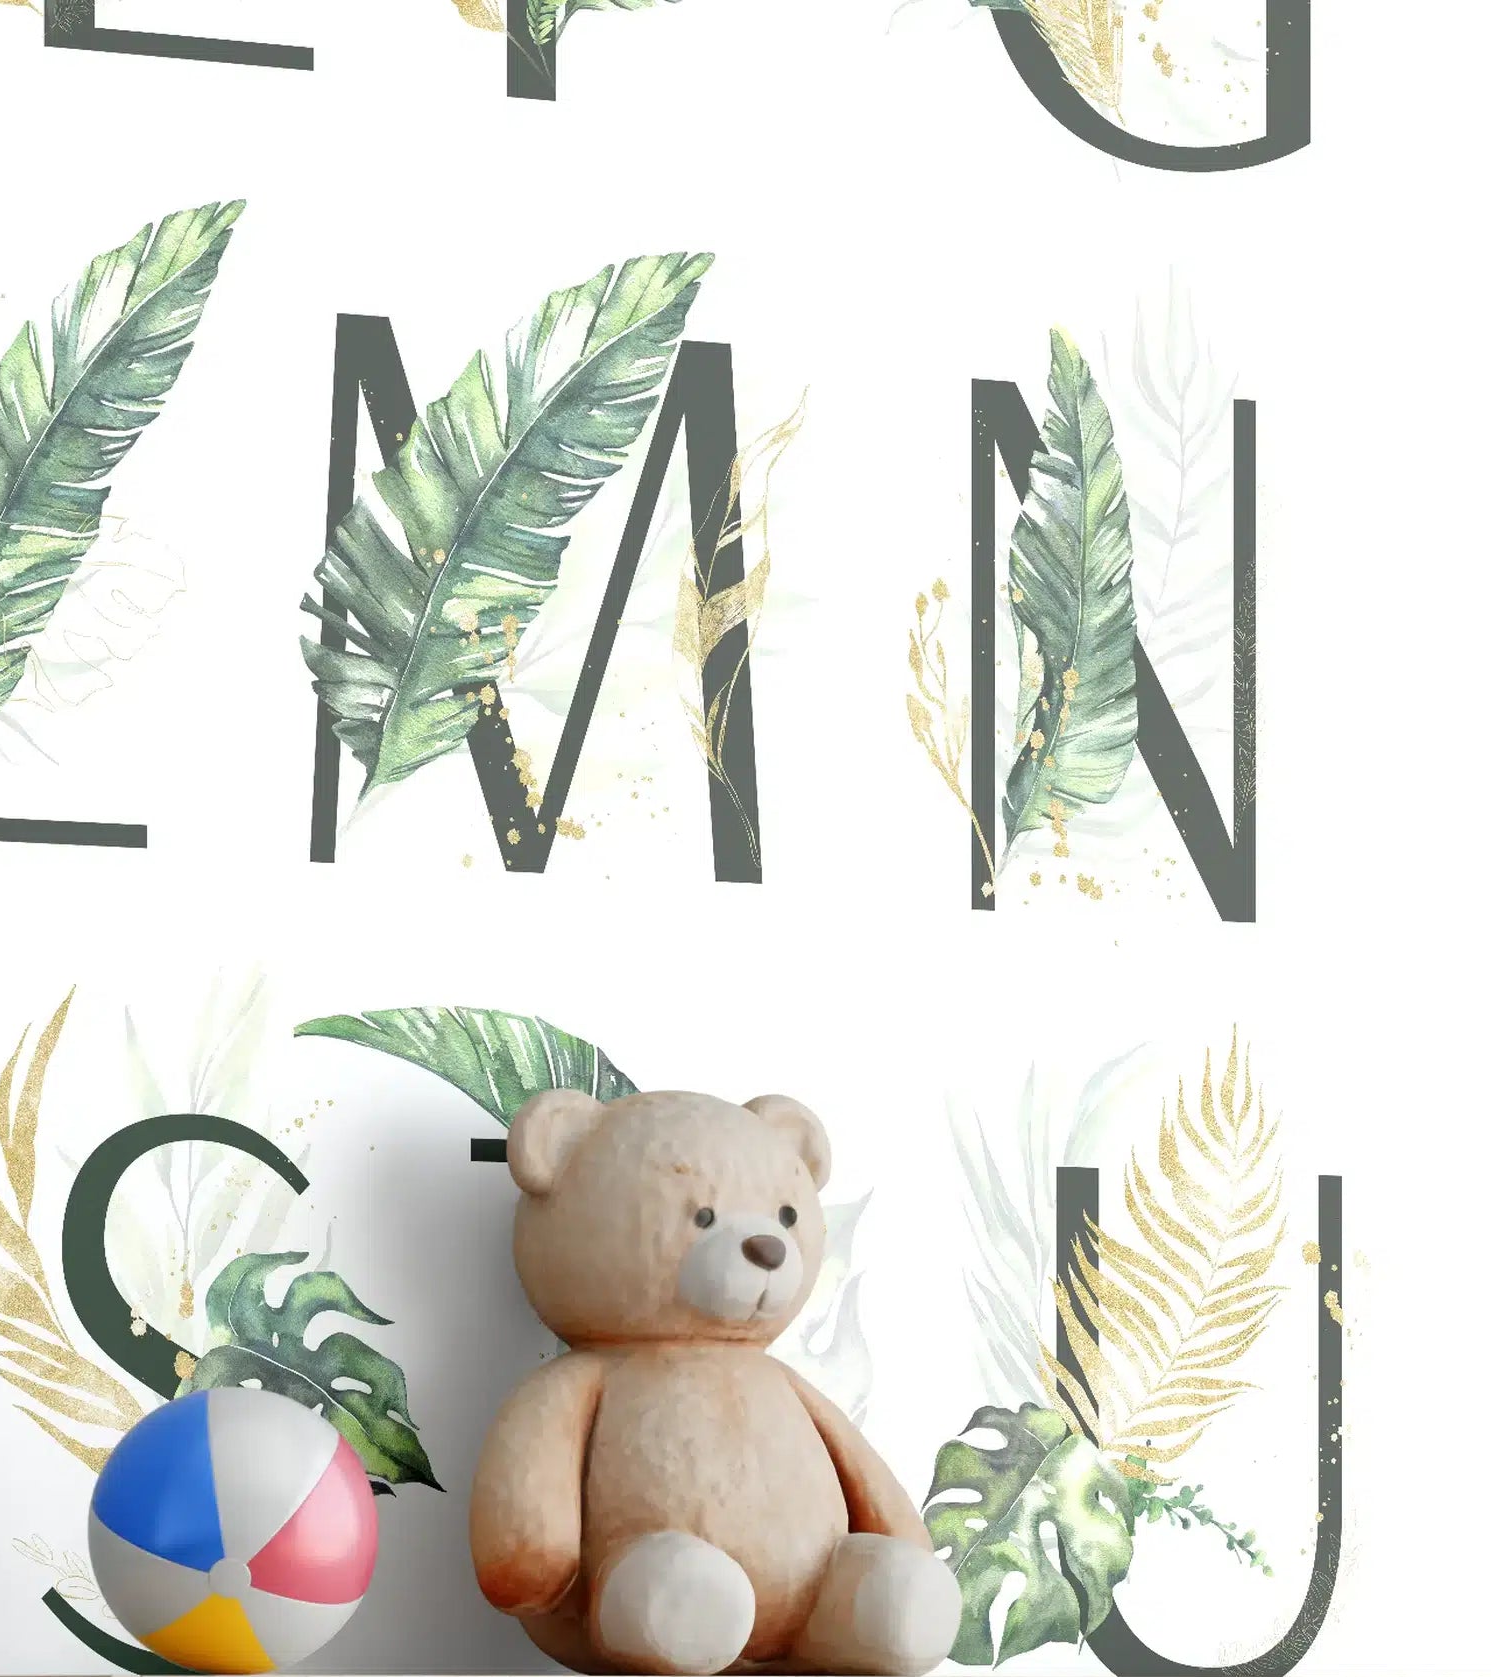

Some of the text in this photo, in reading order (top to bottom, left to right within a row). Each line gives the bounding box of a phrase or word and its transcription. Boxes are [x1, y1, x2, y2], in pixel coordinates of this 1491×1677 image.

[310, 312, 763, 884] M
[971, 378, 1257, 923] N
[1056, 1166, 1343, 1677] U
